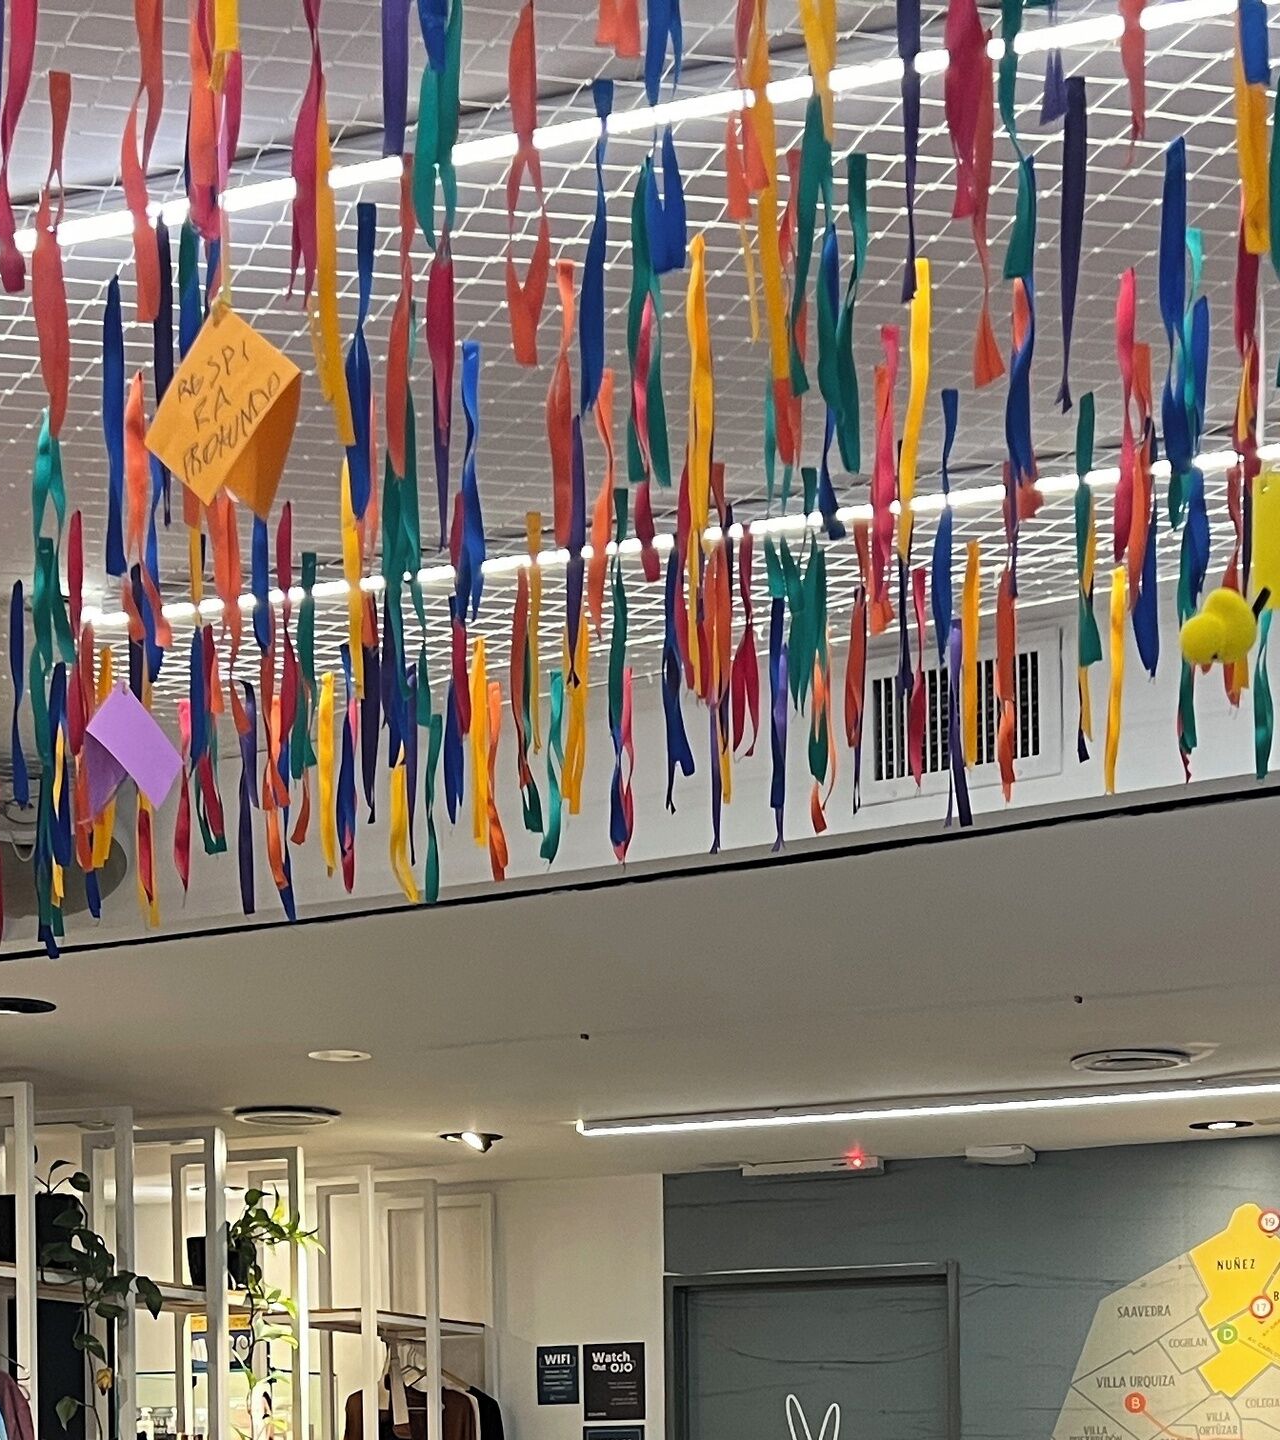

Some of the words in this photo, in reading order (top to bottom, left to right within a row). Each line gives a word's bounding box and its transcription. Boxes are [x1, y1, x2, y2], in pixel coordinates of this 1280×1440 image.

[1216, 1257, 1256, 1270] NUÑEZ
[1117, 1304, 1171, 1319] SAAVEDRA
[1168, 1336, 1208, 1350] COGHLAN
[544, 1353, 571, 1366] WIFI
[591, 1351, 631, 1364] Watch
[610, 1362, 633, 1373] OJO
[1096, 1376, 1126, 1388] VILLA
[1129, 1374, 1176, 1388] URQUIZA
